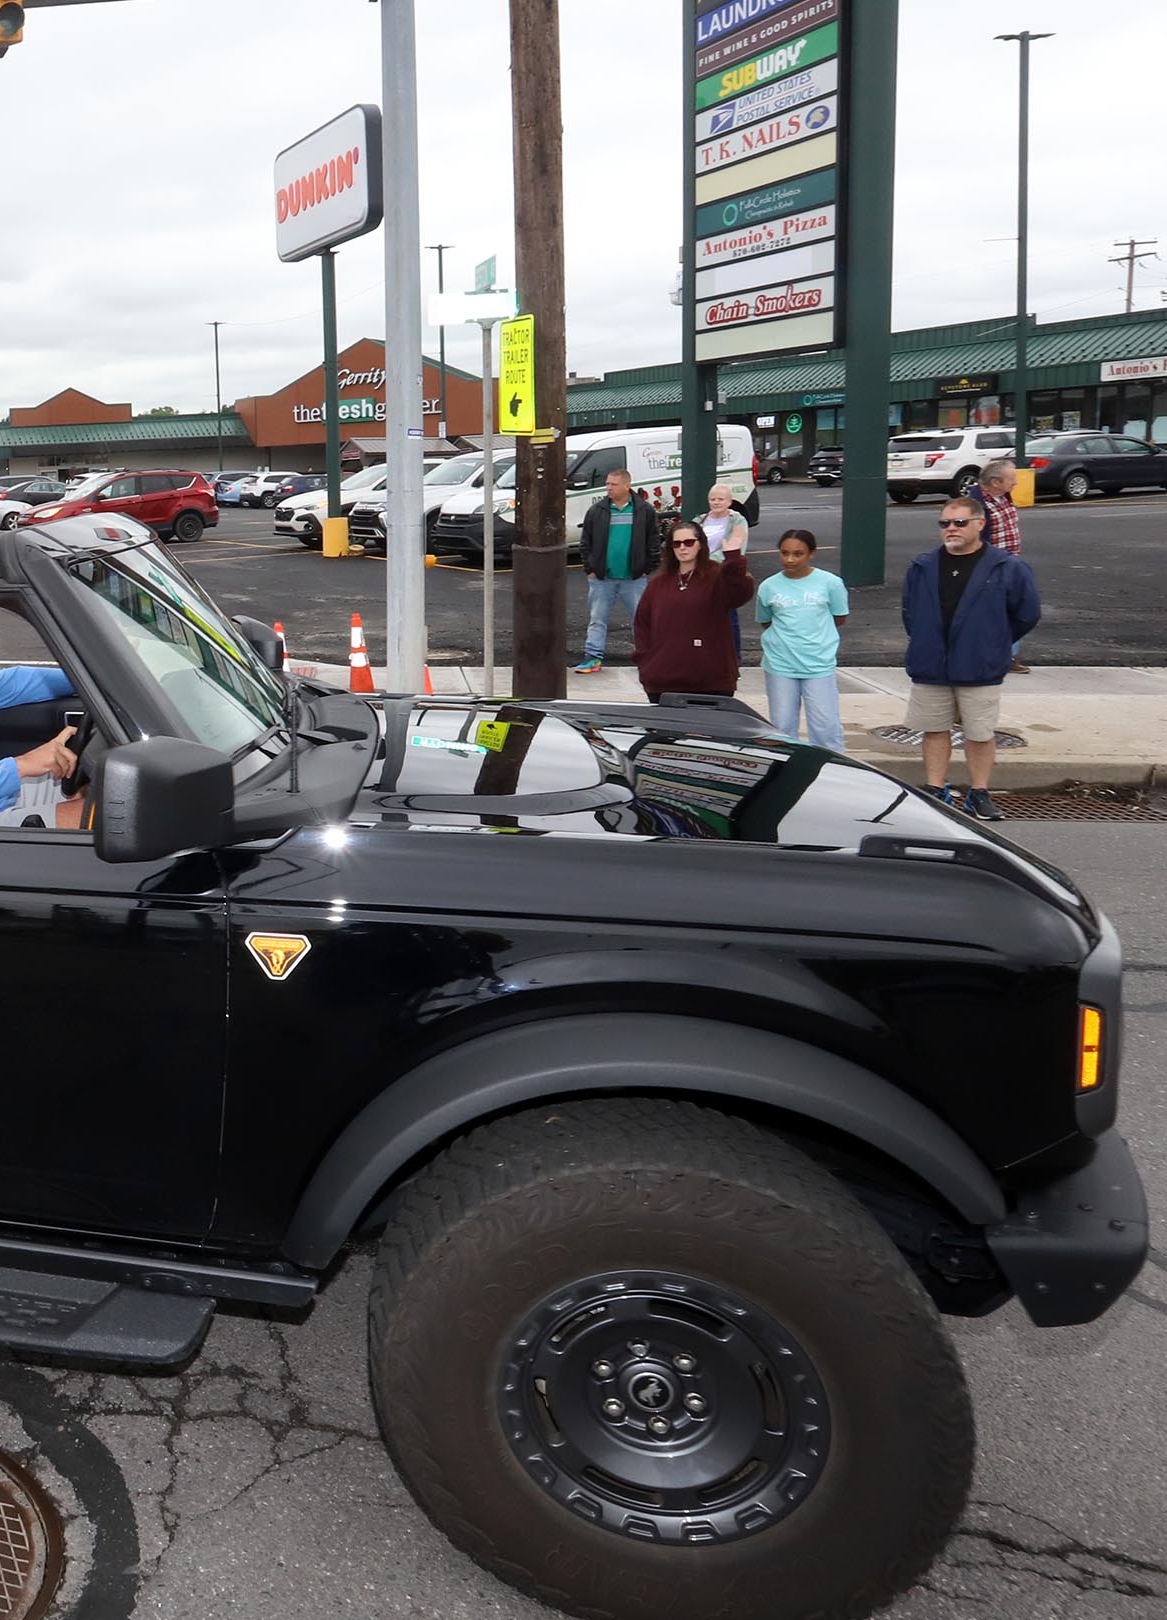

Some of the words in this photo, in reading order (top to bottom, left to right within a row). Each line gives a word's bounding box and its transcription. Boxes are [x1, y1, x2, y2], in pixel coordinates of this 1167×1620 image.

[698, 0, 781, 41] LAUND
[699, 54, 720, 67] FINE
[723, 38, 749, 55] WINE
[751, 33, 757, 43] &
[760, 20, 788, 38] GOOD
[791, 0, 834, 25] SPIRITS
[718, 39, 807, 97] SUBWAY
[736, 104, 771, 125] POSTAL
[774, 86, 814, 110] SERVICE
[738, 86, 774, 109] UNITED
[776, 70, 812, 94] STATES
[742, 113, 802, 152] NAILS
[277, 146, 359, 224] DUNKIN'
[703, 225, 774, 256] Antonio's
[784, 214, 828, 236] Pizza
[706, 301, 748, 325] Chain
[754, 284, 822, 316] Smokers
[502, 328, 531, 347] TRACTOR
[503, 348, 529, 365] TRAILER
[505, 368, 526, 385] ROUTE
[1107, 361, 1158, 375] Antonio's
